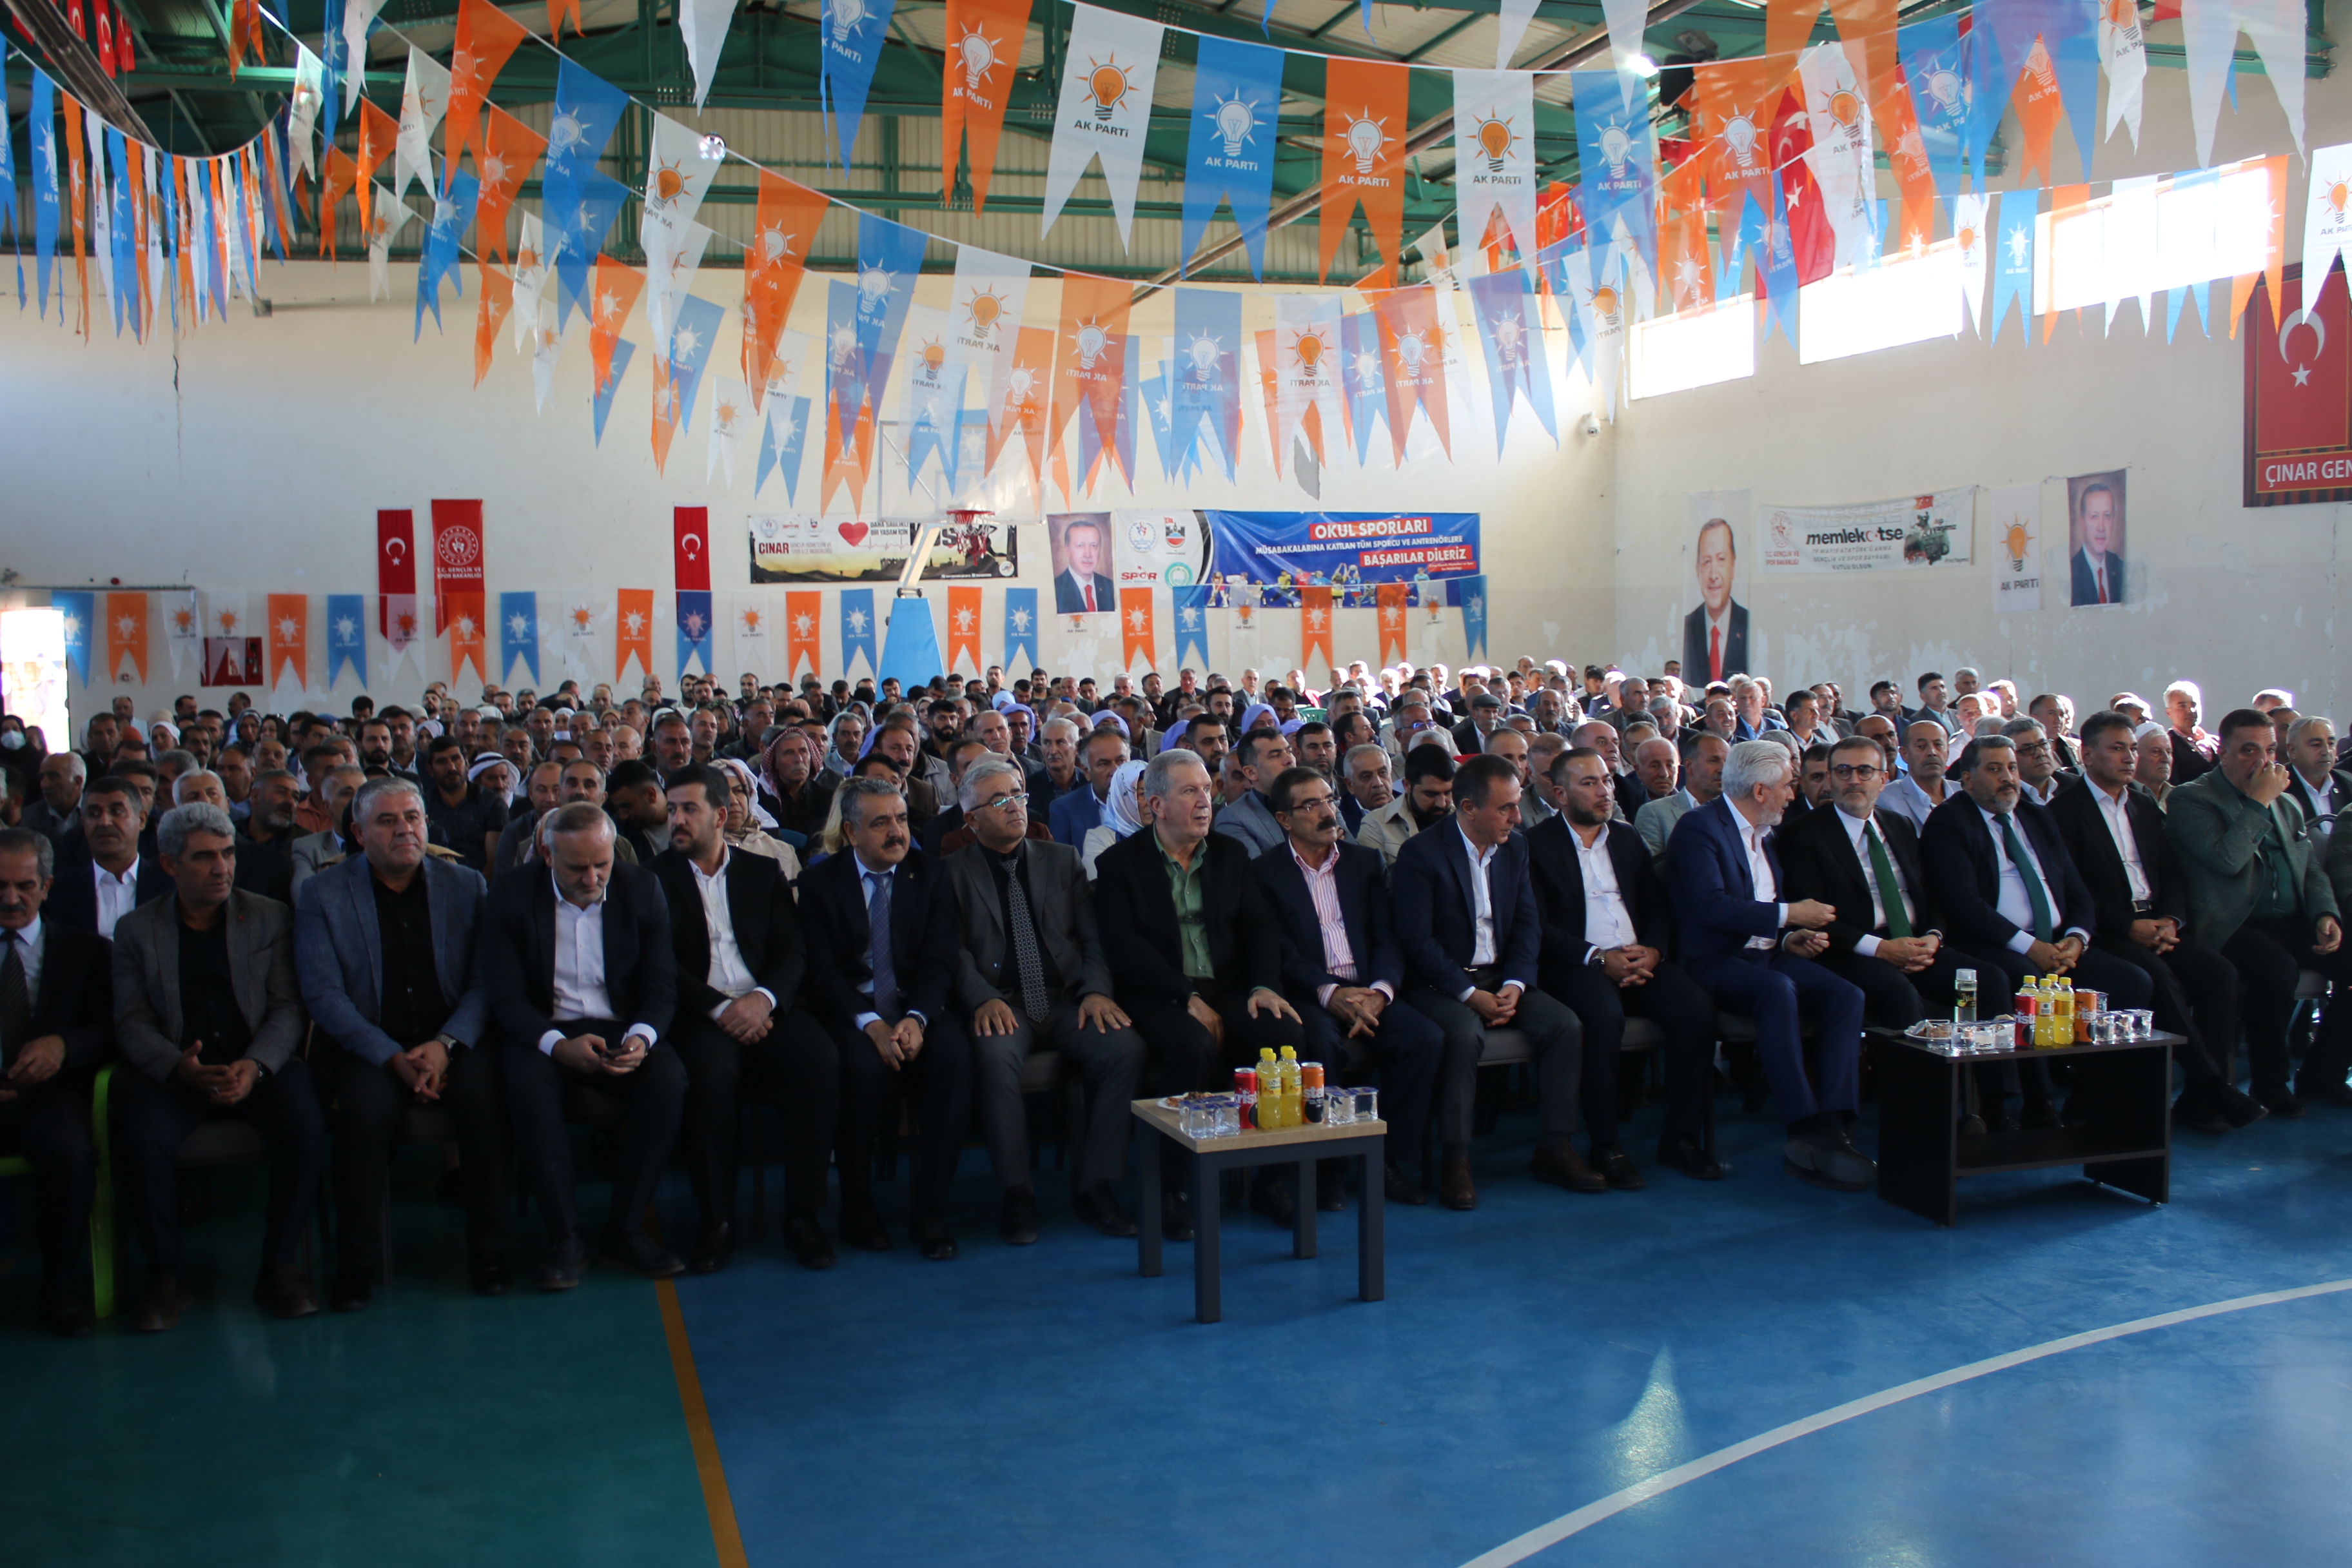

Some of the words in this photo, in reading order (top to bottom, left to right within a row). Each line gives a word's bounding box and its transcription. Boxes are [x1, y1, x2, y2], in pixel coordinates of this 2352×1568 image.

[1074, 120, 1092, 131] AK
[1832, 144, 1847, 155] AK
[1206, 157, 1221, 166] AK
[1339, 175, 1355, 184] AK
[1473, 175, 1488, 184] AK
[1724, 172, 1739, 181] AK
[1598, 182, 1611, 191] AK
[2265, 462, 2318, 488] ÇINAR
[1314, 523, 1356, 539] OKUL
[1358, 518, 1428, 537] SPORLARI
[759, 542, 789, 555] ÇINAR
[1255, 544, 1324, 555] MÜSABAKALARINA
[1326, 542, 1355, 551] KATILAN
[1357, 540, 1373, 549] TÜM
[1373, 539, 1400, 548] SPORCU
[1402, 538, 1411, 546] VE
[1412, 534, 1463, 546] ANTRENÖRLERE
[1364, 551, 1424, 568] BAŞARILAR
[1427, 546, 1467, 564] DİLERİZ
[1121, 572, 1158, 580] SPOR
[2001, 582, 2012, 591] AK
